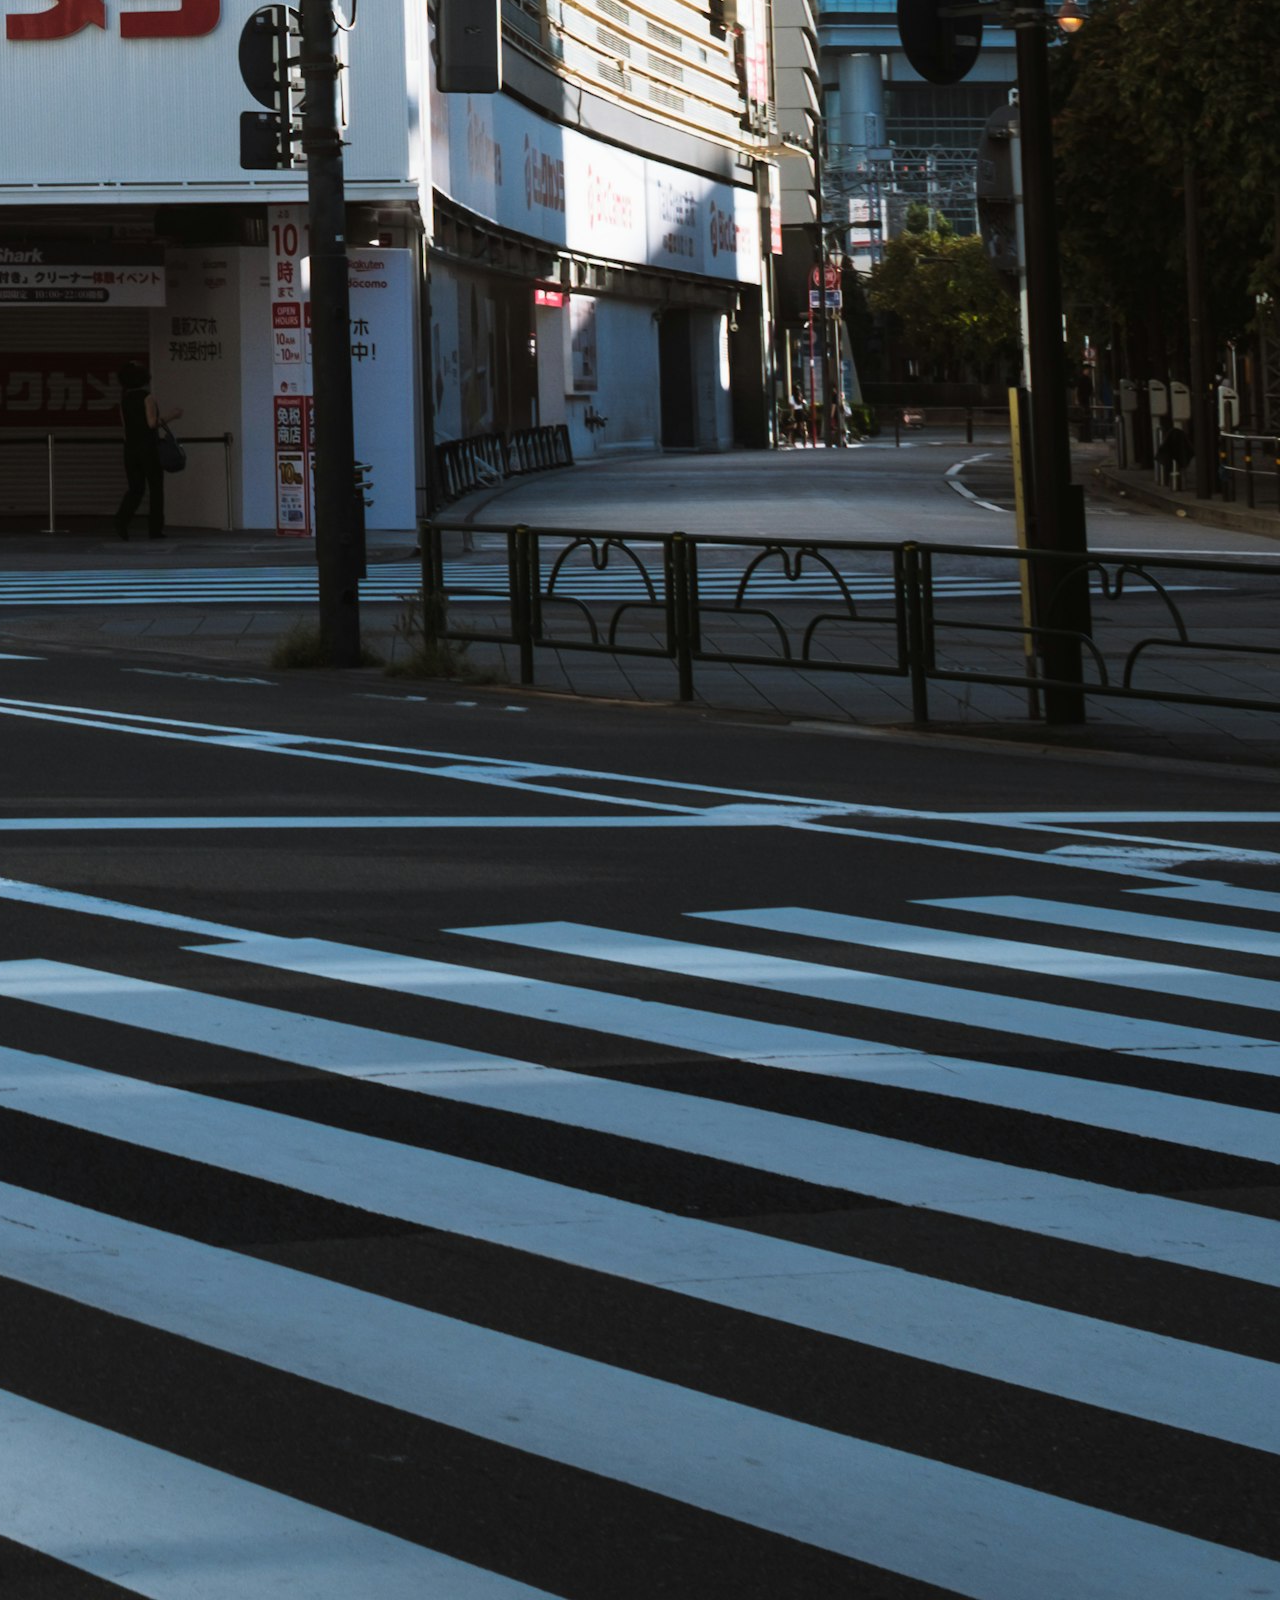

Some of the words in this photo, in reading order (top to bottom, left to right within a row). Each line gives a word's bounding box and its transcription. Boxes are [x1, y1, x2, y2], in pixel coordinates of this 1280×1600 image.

[272, 223, 298, 256] 10
[277, 261, 294, 284] 時
[277, 287, 294, 298] まで
[277, 306, 297, 315] OPEN
[171, 316, 218, 336] 最新スマホ
[275, 316, 299, 326] HOURS
[277, 407, 302, 425] 免税
